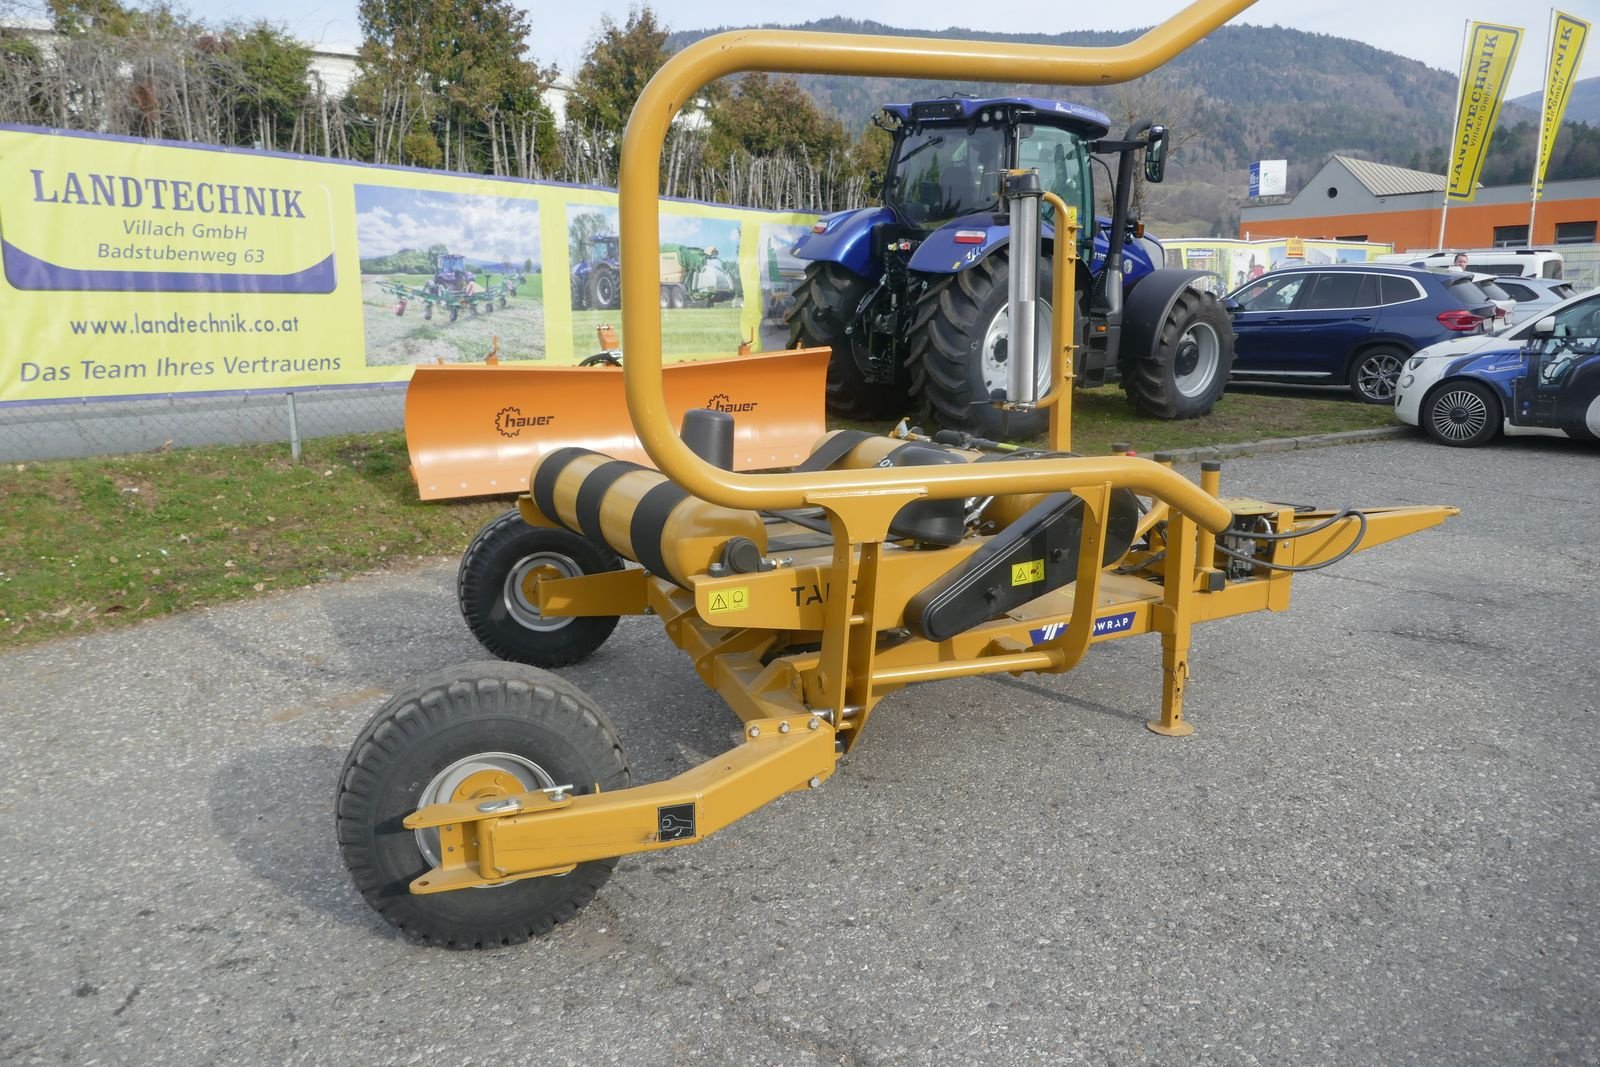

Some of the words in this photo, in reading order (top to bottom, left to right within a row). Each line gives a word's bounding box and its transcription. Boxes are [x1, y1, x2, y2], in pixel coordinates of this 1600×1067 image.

[1450, 33, 1499, 190] LANDTECHNIK
[30, 169, 306, 219] LANDTECHNIK
[123, 219, 185, 238] Villach
[192, 223, 248, 241] GmbH
[98, 243, 237, 266] Badstubenweg
[244, 249, 265, 264] 63
[70, 312, 299, 335] www.landtechnik.co.at
[20, 362, 71, 383] Das
[80, 360, 147, 380] Team
[156, 357, 215, 377] Ihres
[223, 354, 341, 375] Vertrauens
[715, 400, 759, 413] hauer
[505, 413, 555, 428] hauer
